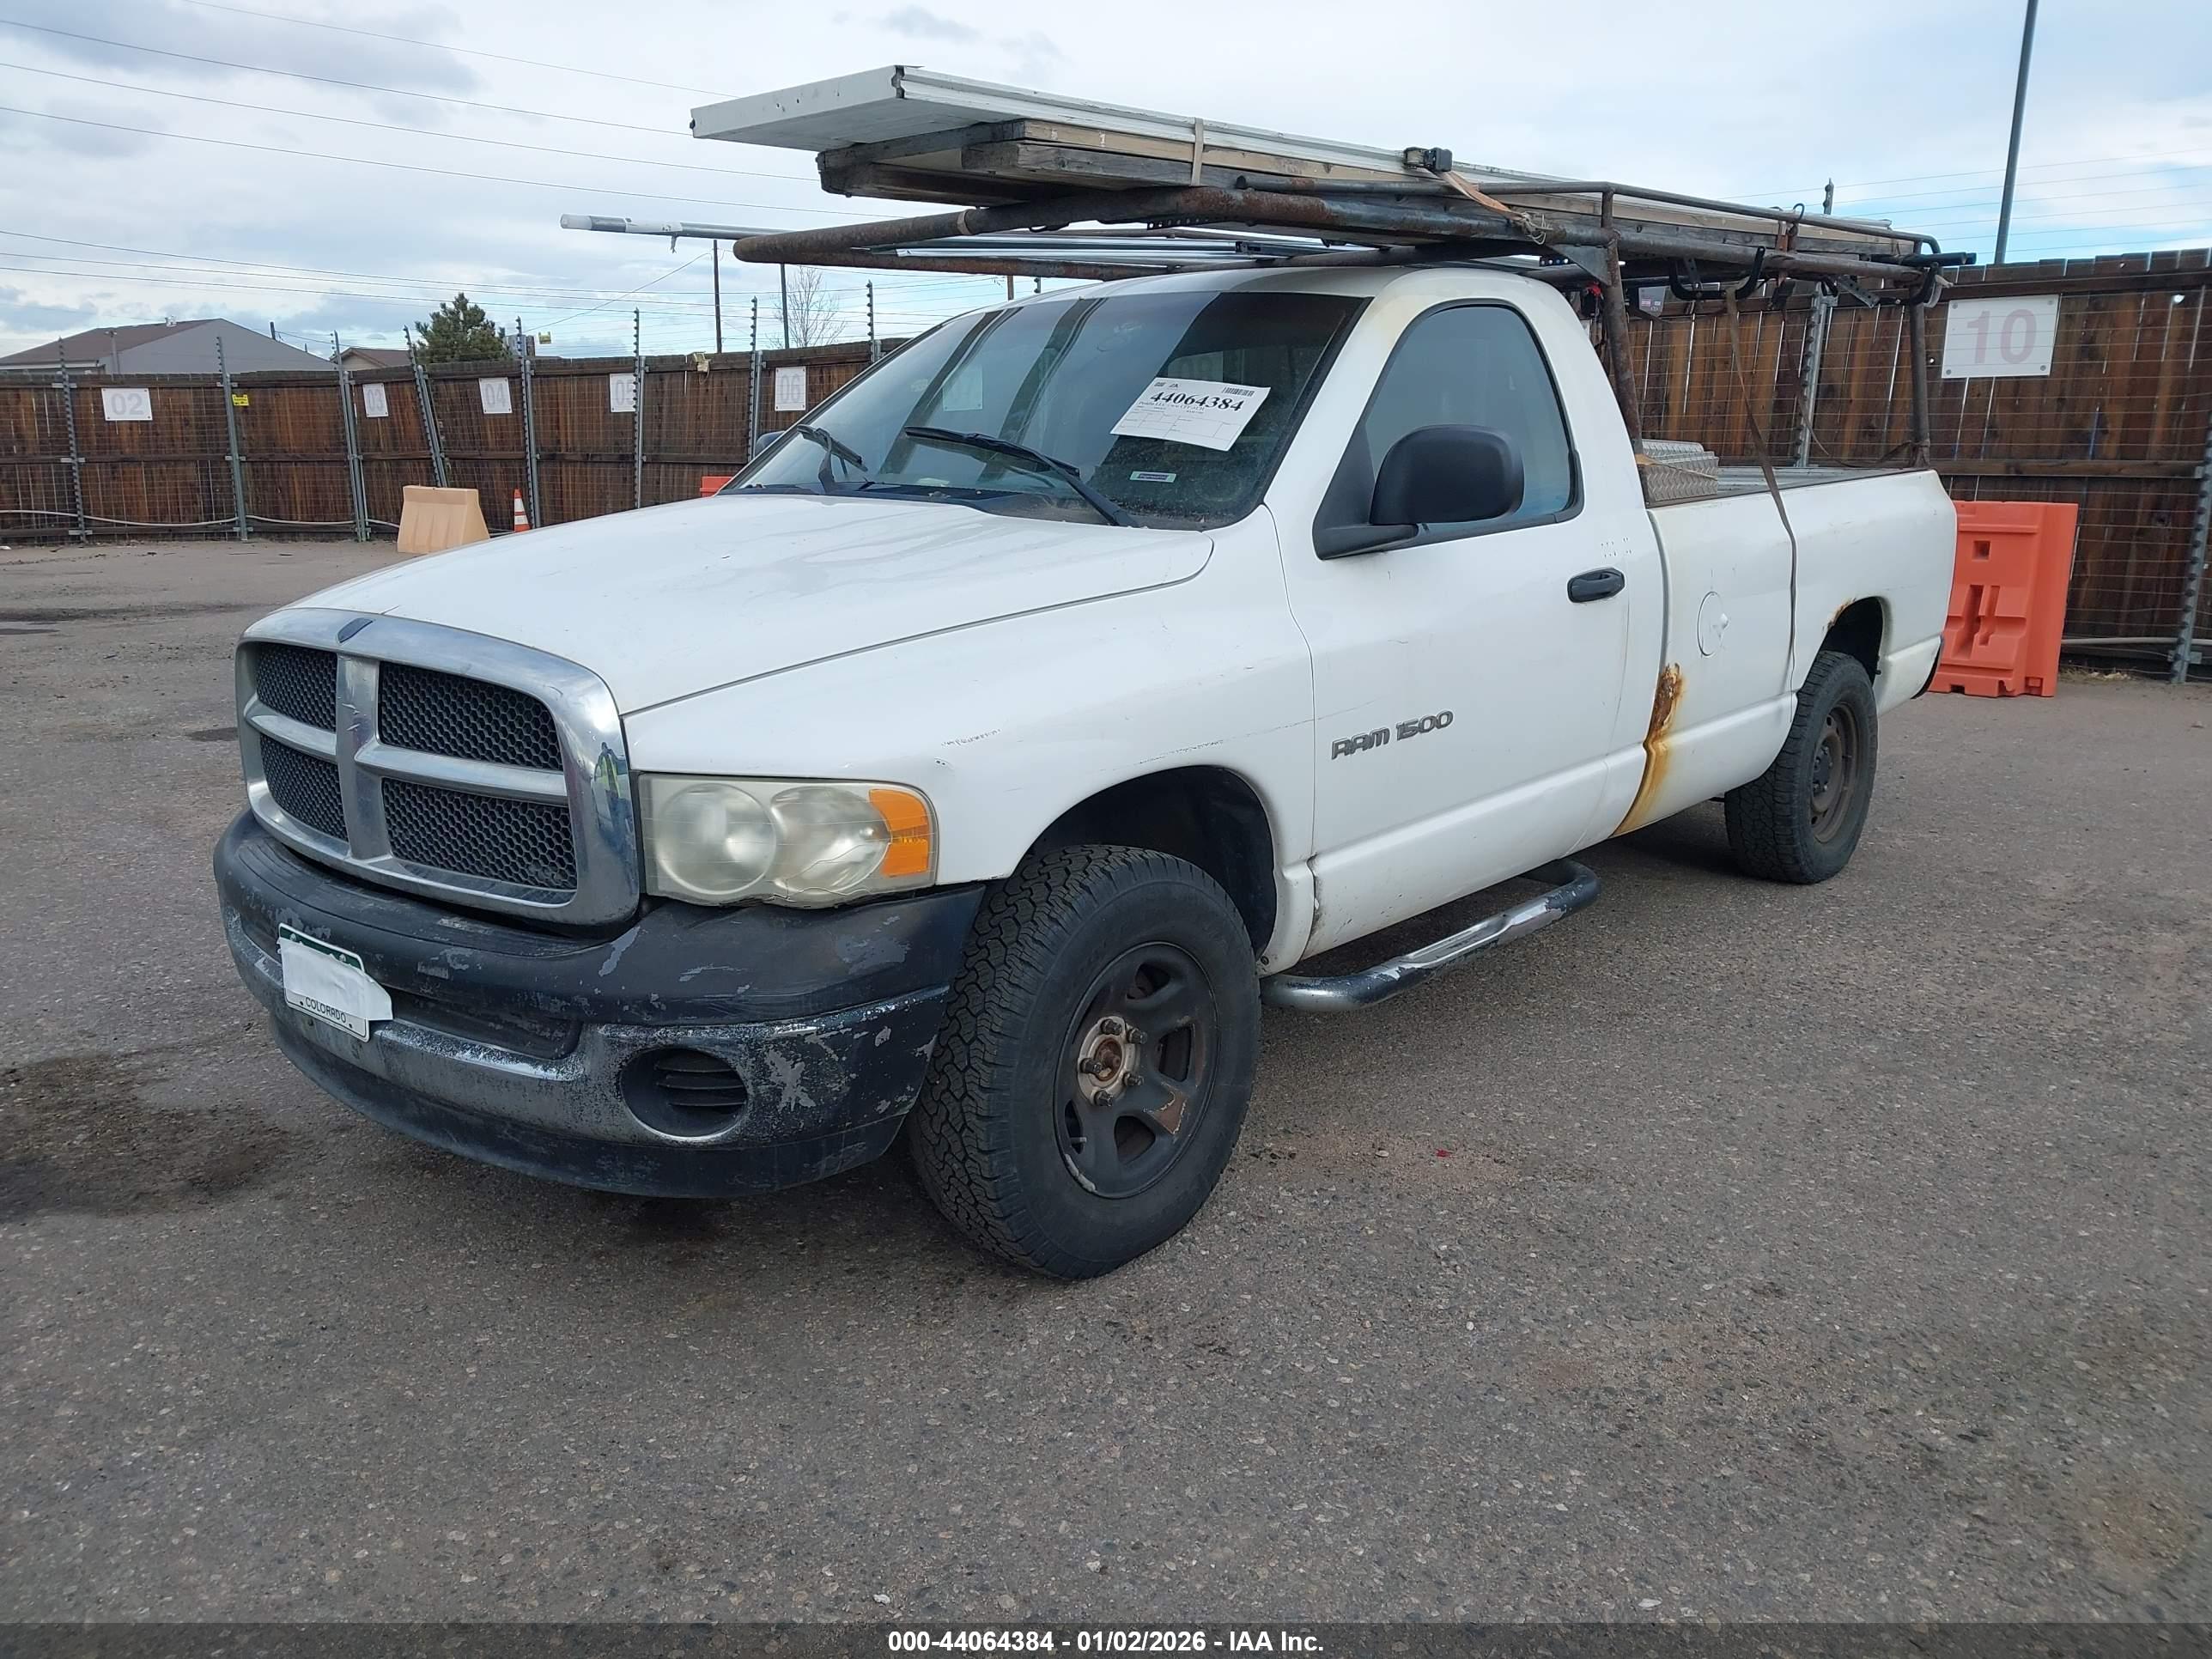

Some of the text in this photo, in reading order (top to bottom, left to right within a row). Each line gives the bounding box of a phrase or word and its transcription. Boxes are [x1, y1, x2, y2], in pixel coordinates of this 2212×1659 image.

[1966, 309, 2037, 363] 10
[111, 393, 144, 416] 02
[485, 383, 507, 408] 04
[1151, 392, 1245, 412] 44064384
[1331, 710, 1454, 760] RAM 1500
[305, 996, 347, 1023] COLORADO
